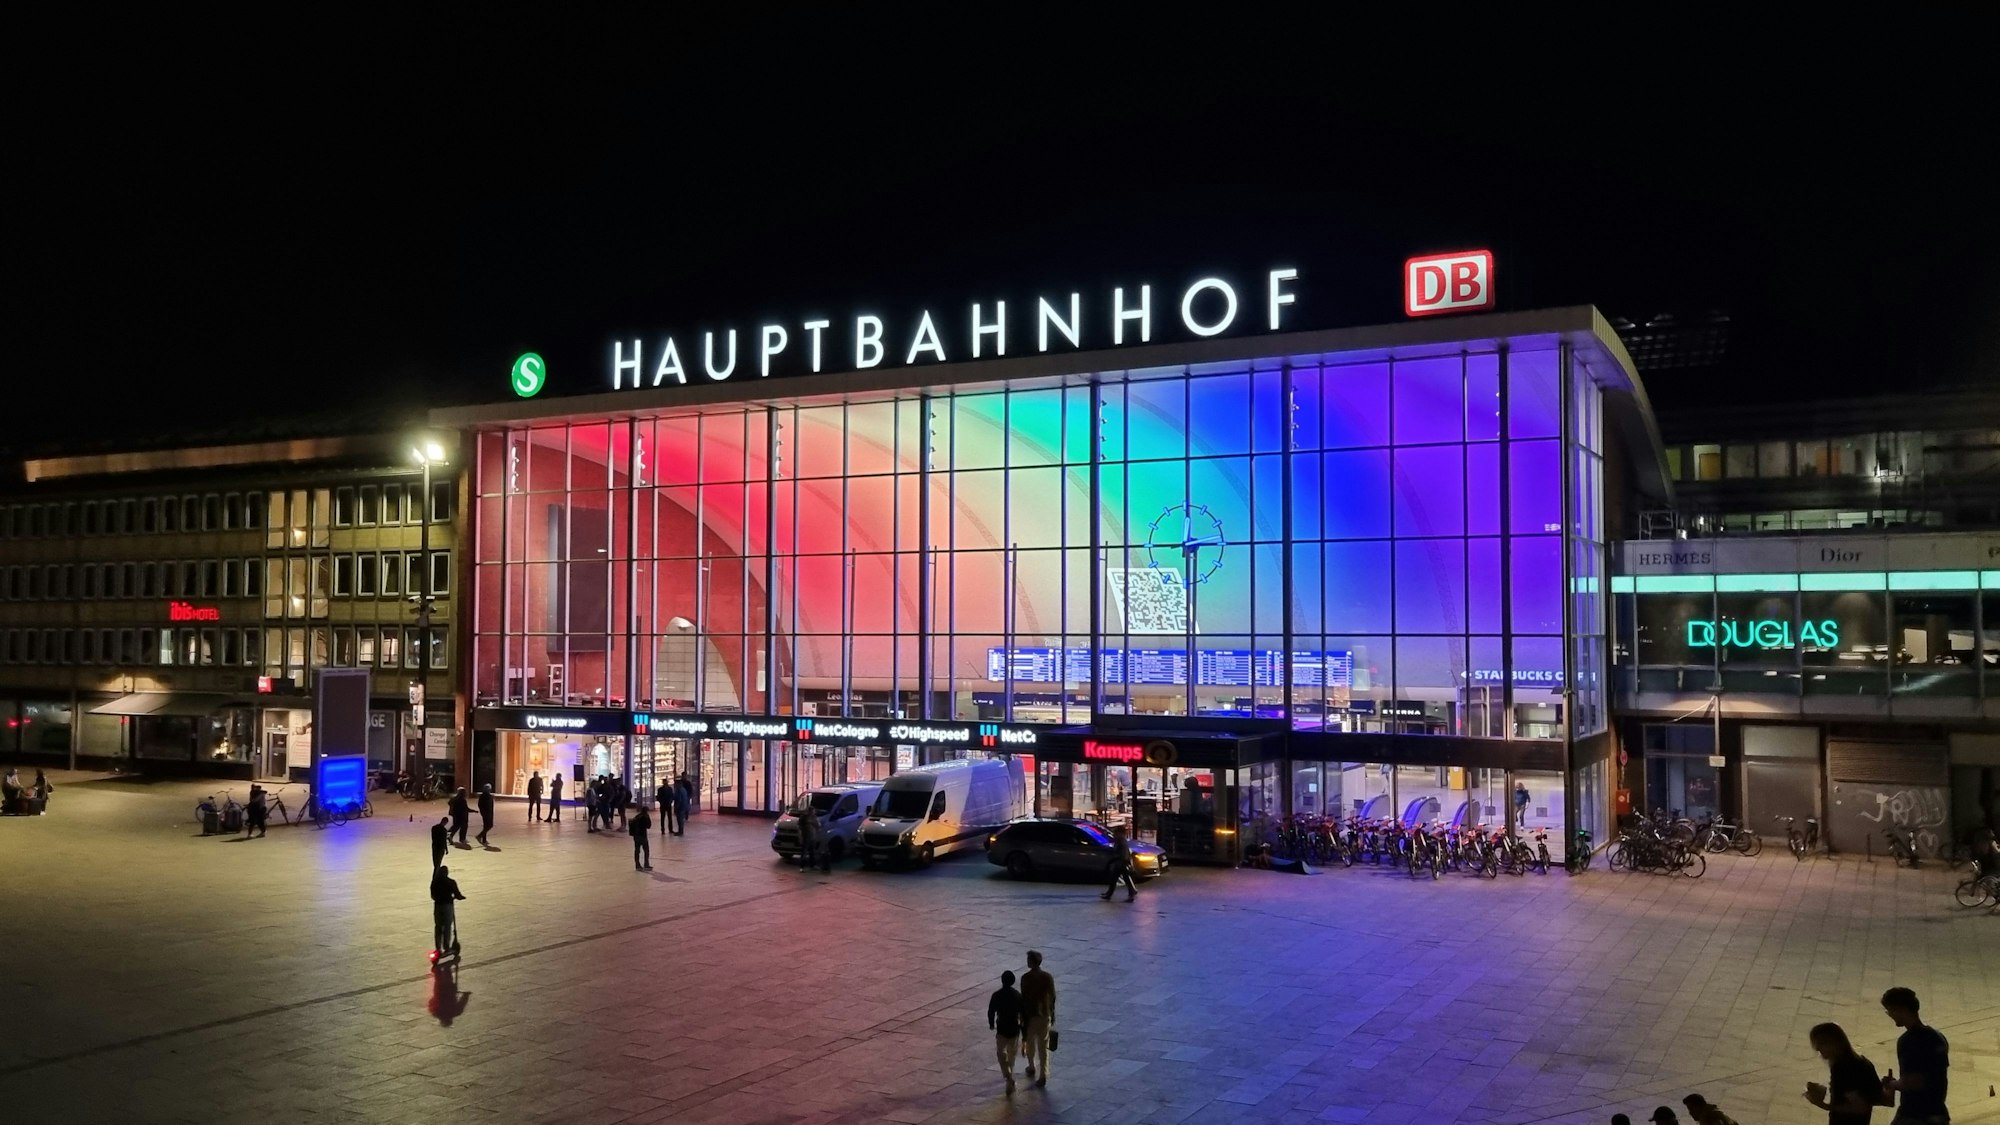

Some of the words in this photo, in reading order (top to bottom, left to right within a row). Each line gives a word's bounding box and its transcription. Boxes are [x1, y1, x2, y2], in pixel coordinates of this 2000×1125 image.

[1415, 260, 1483, 306] DB
[613, 268, 1299, 391] HAUPTBAHNHOF
[516, 355, 543, 394] S
[1820, 546, 1864, 564] Dior
[170, 602, 193, 621] ibis
[193, 607, 220, 621] HOTEL
[1687, 620, 1840, 649] DOUGLAS
[1474, 670, 1552, 682] STABUCKS
[1382, 708, 1421, 716] ETERNA
[538, 718, 550, 727] THE
[551, 718, 568, 728] BODY
[568, 718, 587, 728] SHOP
[650, 718, 708, 734] NetCologne
[733, 721, 788, 737] Highspeed
[814, 724, 879, 740] NetCologne
[908, 726, 969, 742] Highspeed
[1084, 741, 1143, 763] Kamps
